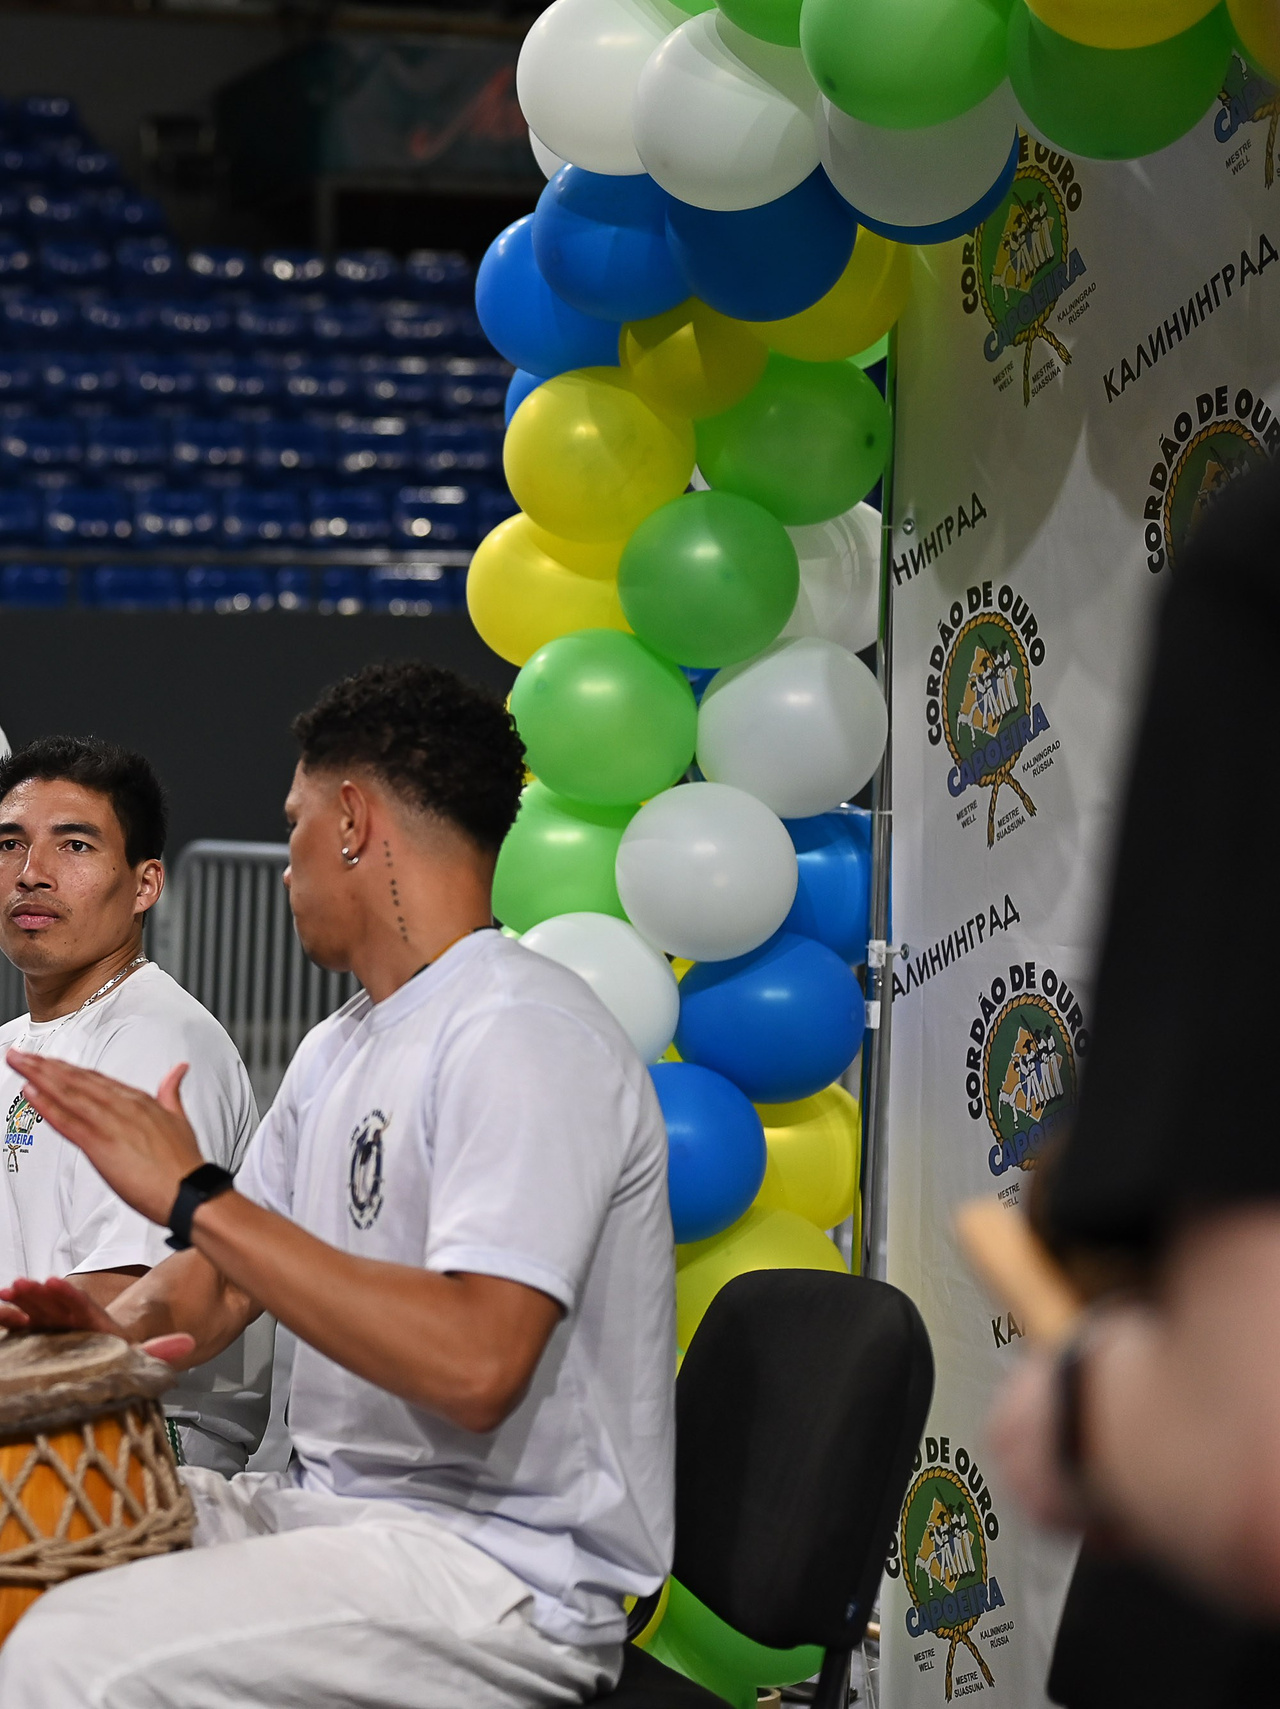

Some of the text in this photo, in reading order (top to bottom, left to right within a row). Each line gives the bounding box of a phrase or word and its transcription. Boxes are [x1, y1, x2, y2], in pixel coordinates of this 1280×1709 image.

[1225, 139, 1252, 169] MESTRE
[1231, 155, 1251, 176] WELL
[1035, 141, 1082, 212] OURO
[983, 247, 1087, 363] CAPOEIRA
[1056, 282, 1097, 323] KALININGRAD
[1102, 233, 1280, 403] КАЛИНИНГРАД
[992, 360, 1014, 386] MESTRE
[998, 376, 1014, 392] WELL
[1031, 358, 1055, 384] MESTRE
[1031, 365, 1061, 398] SUASSUNA
[1143, 385, 1280, 574] CORDÃO DE OUR
[892, 491, 987, 588] НИНГРАД
[926, 580, 1046, 746] CORDÃO DE OURO
[947, 702, 1051, 798] CAPOEIRA
[1021, 740, 1061, 773] KALININGRAD
[956, 799, 978, 821] MESTRE
[961, 814, 977, 829] WELL
[997, 806, 1020, 828] MESTRE
[996, 815, 1026, 841] SUASSUNA
[965, 962, 1090, 1120] CORDÃO DE OURO
[997, 1182, 1021, 1201] MESTRE
[925, 1436, 950, 1464] DE
[955, 1447, 999, 1541] OURO
[905, 1576, 1006, 1638] CAPOEIRA
[980, 1621, 1015, 1641] KALININGRAD
[913, 1648, 936, 1662] MESTRE
[918, 1661, 935, 1672] WELL
[954, 1681, 985, 1698] SUASSUNA
[955, 1671, 979, 1685] MESTRE
